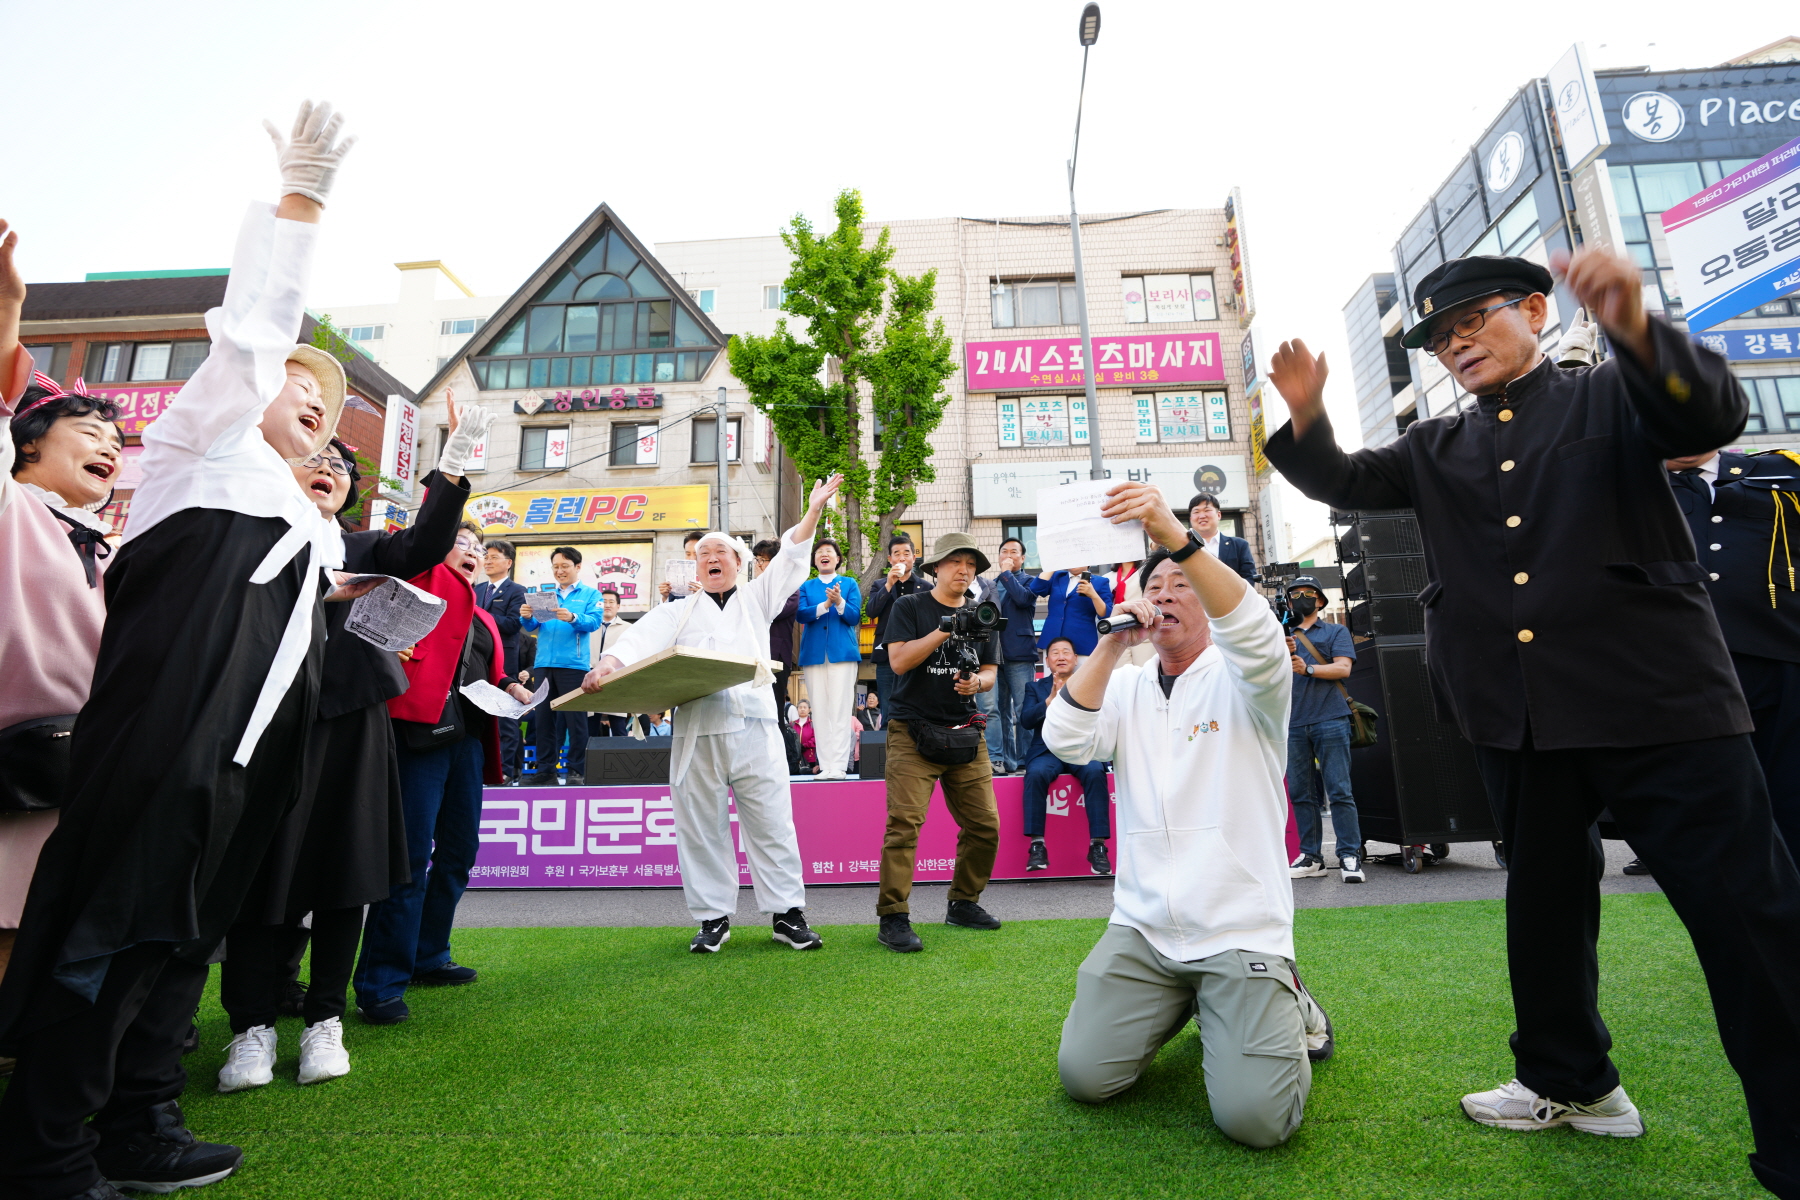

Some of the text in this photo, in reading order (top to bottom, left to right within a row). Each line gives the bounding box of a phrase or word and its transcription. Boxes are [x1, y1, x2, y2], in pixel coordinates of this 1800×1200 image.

[1643, 96, 1800, 135] 봉 Place
[1692, 187, 1723, 210] 1960
[1723, 160, 1770, 194] 거리재현
[1148, 288, 1190, 303] 보리사
[1764, 304, 1783, 313] 24시
[1744, 332, 1800, 355] 강북
[1113, 371, 1136, 382] 완비
[1140, 369, 1159, 381] 3층
[551, 386, 657, 412] 성인용품
[1161, 396, 1200, 408] 스포츠
[1025, 400, 1063, 413] 스포츠
[1001, 403, 1016, 442] 피부관리
[1036, 414, 1054, 428] 발
[1072, 401, 1088, 440] 아로마
[1172, 409, 1190, 423] 발
[1210, 397, 1227, 435] 아로마
[1026, 430, 1064, 442] 맛사지
[1163, 425, 1200, 437] 맛사지
[550, 440, 565, 456] 천
[639, 436, 657, 453] 황
[1007, 486, 1022, 499] 있는
[524, 493, 666, 525] 홈런PC 2F
[937, 666, 948, 676] got
[479, 796, 747, 856] 국민문화
[467, 865, 530, 878] 문화제위원회
[544, 865, 565, 878] 후원
[578, 865, 629, 878] 국가보훈부
[812, 861, 834, 874] 협찬
[848, 860, 881, 873] 강북문
